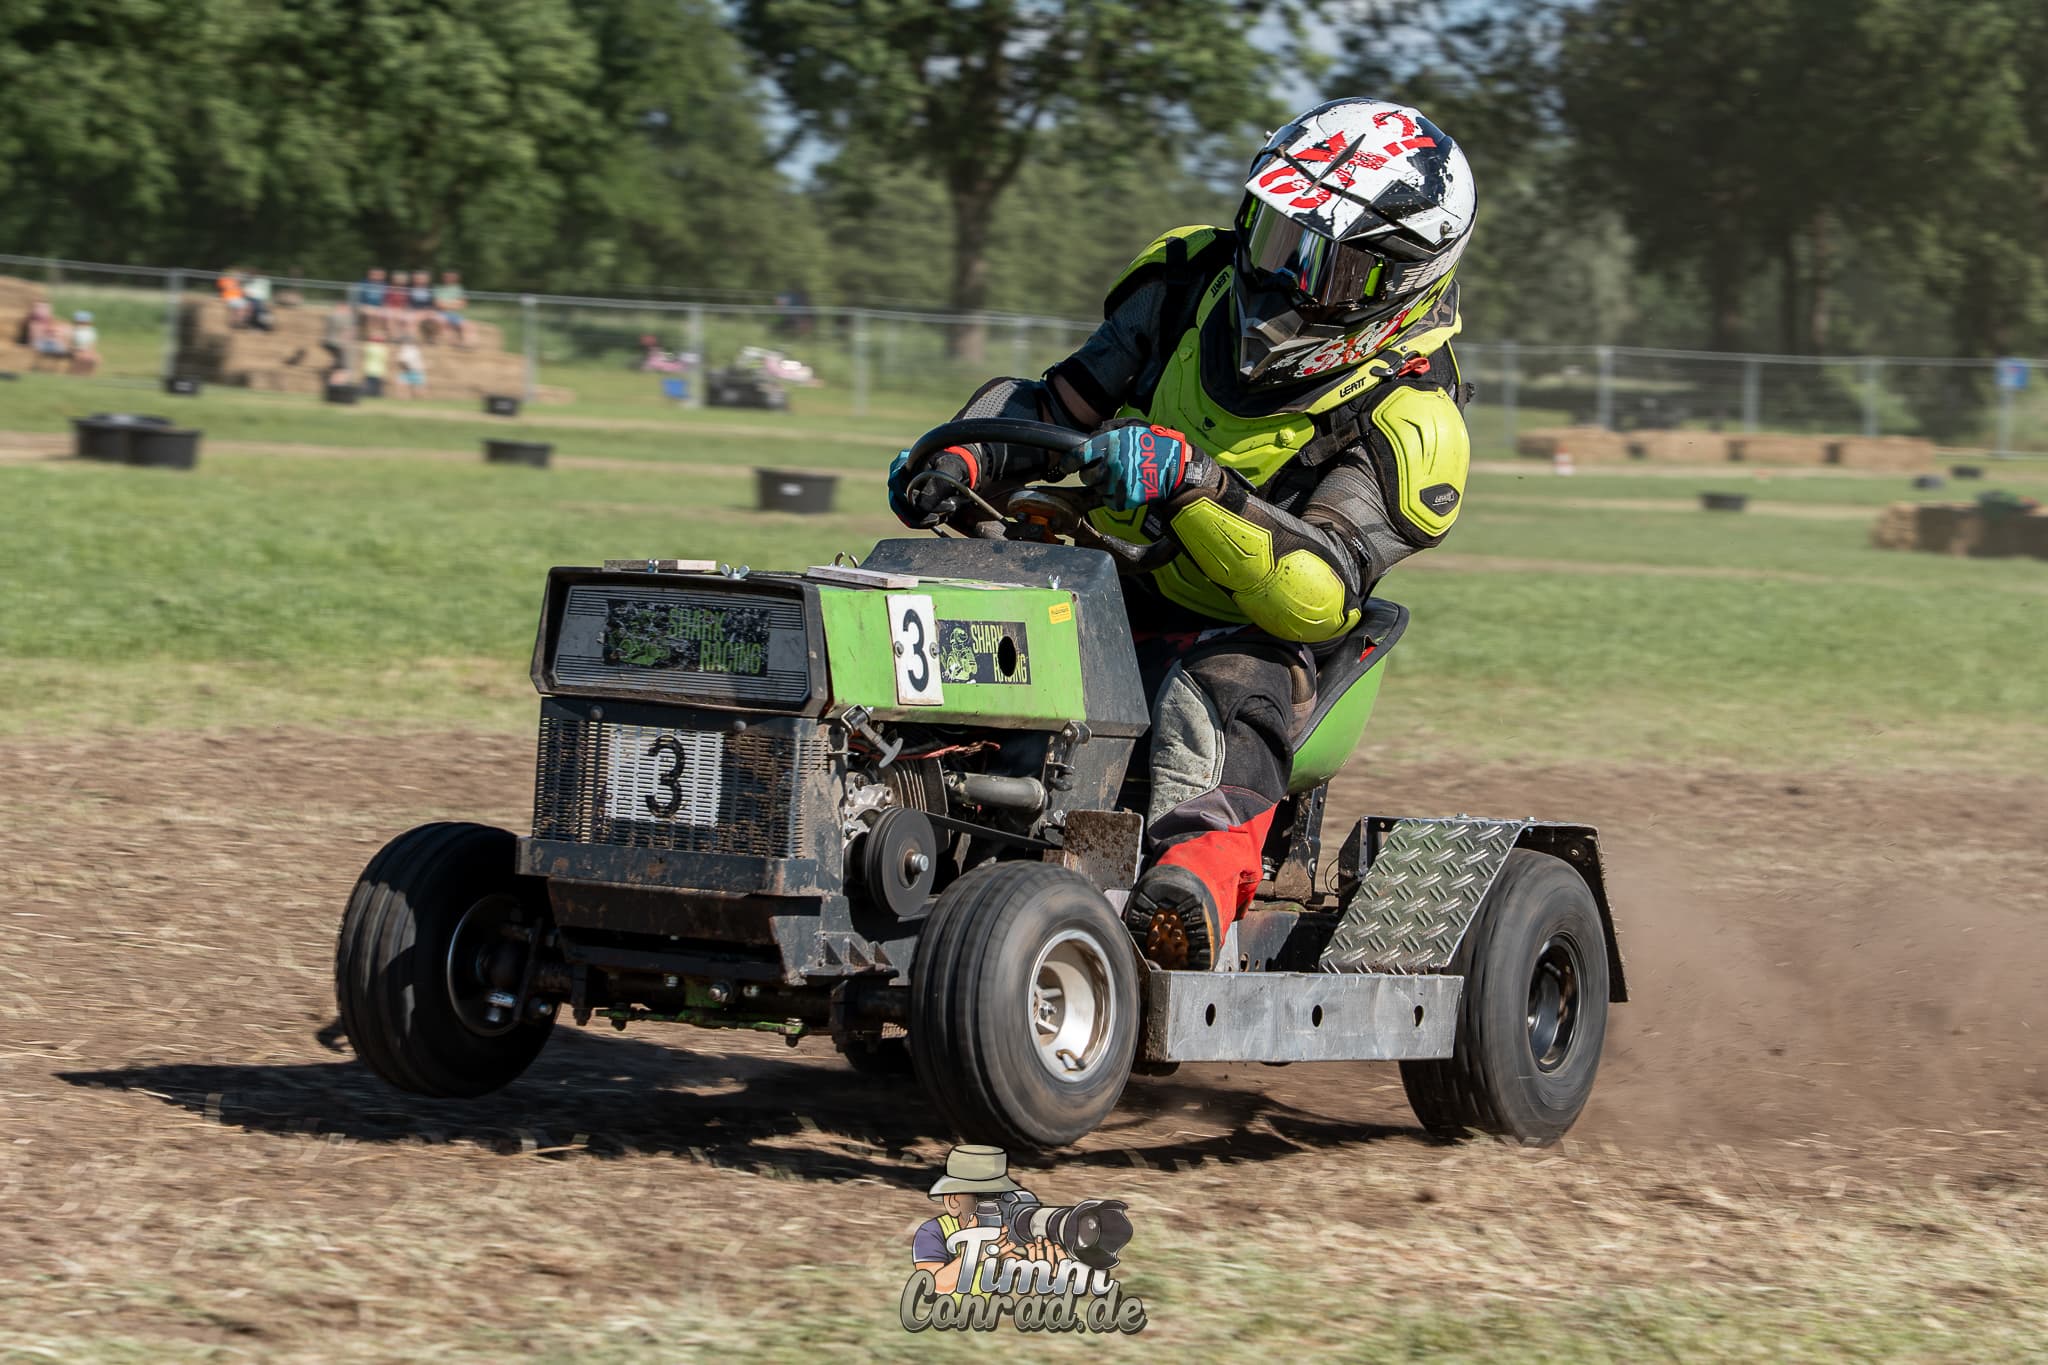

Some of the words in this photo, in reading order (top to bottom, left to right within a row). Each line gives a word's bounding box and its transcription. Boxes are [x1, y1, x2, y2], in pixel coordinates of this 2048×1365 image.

[1339, 376, 1367, 398] LEATT
[1139, 433, 1160, 506] ONEAL
[668, 607, 727, 641] SHARK
[902, 608, 930, 693] 3
[701, 640, 761, 675] RACING
[645, 734, 685, 819] 3
